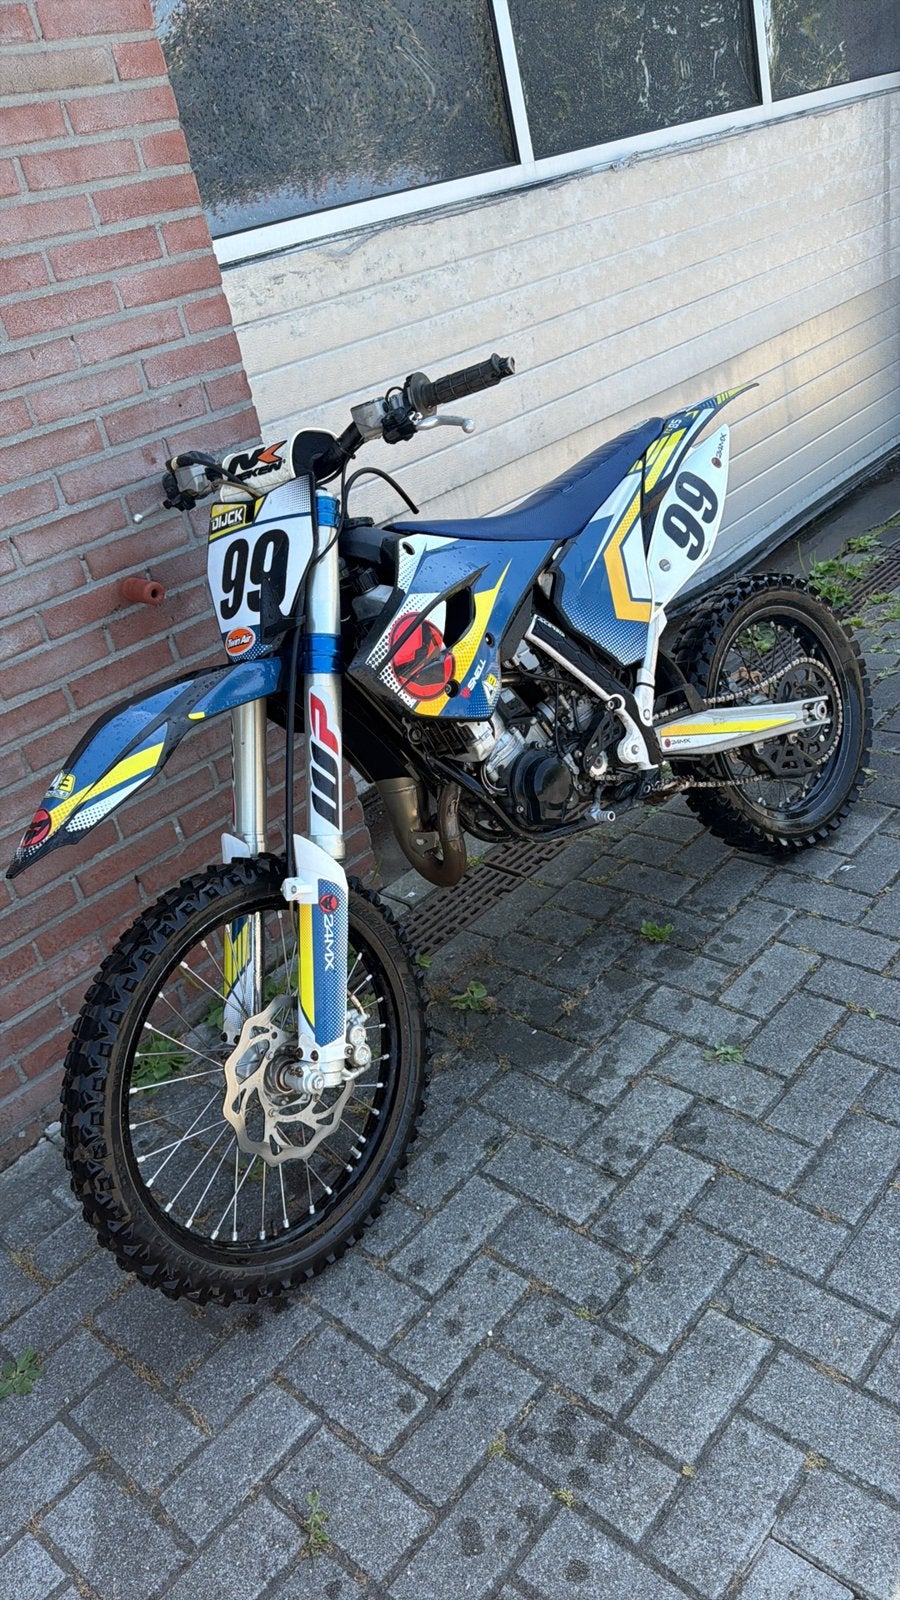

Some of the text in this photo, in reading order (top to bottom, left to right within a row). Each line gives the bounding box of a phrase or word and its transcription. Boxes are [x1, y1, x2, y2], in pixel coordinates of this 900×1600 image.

[715, 433, 727, 458] 24MX
[236, 460, 284, 480] EKEN
[212, 508, 244, 531] DIJCK
[662, 471, 718, 561] 99
[220, 529, 290, 620] 99
[467, 659, 487, 690] SNELL
[323, 913, 335, 972] 24MX
